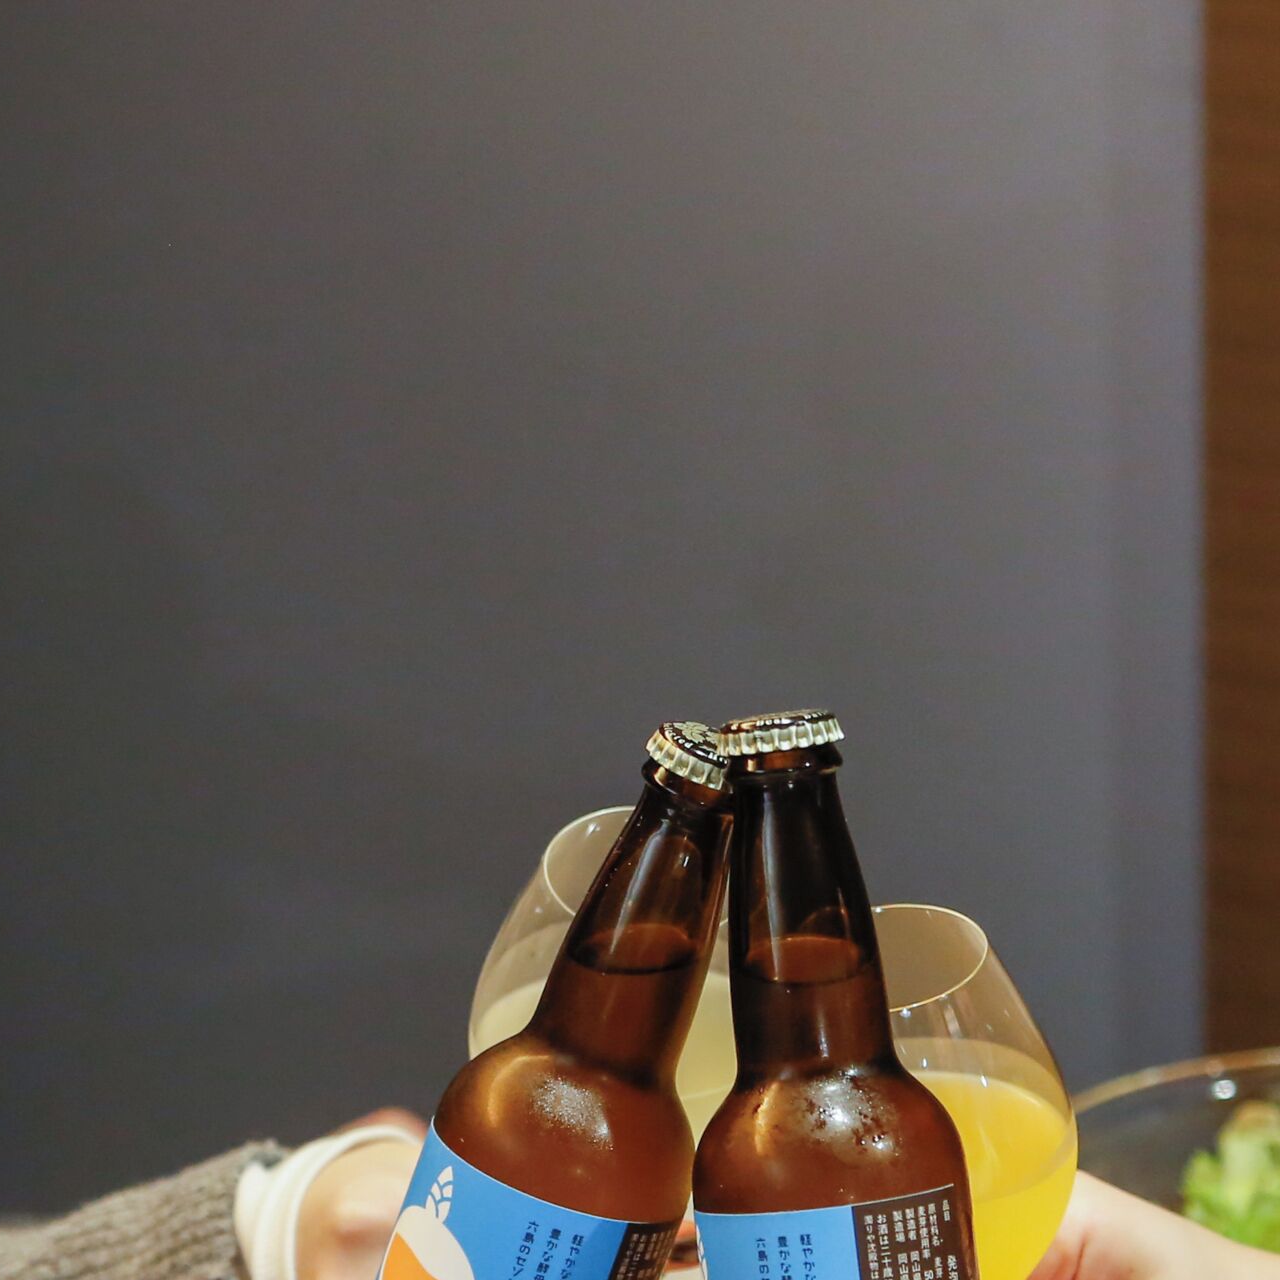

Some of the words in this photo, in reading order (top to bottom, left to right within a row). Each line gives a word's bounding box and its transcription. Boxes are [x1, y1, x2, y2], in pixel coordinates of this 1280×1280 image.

[892, 1210, 905, 1243] 製造場
[905, 1208, 917, 1241] 製造者
